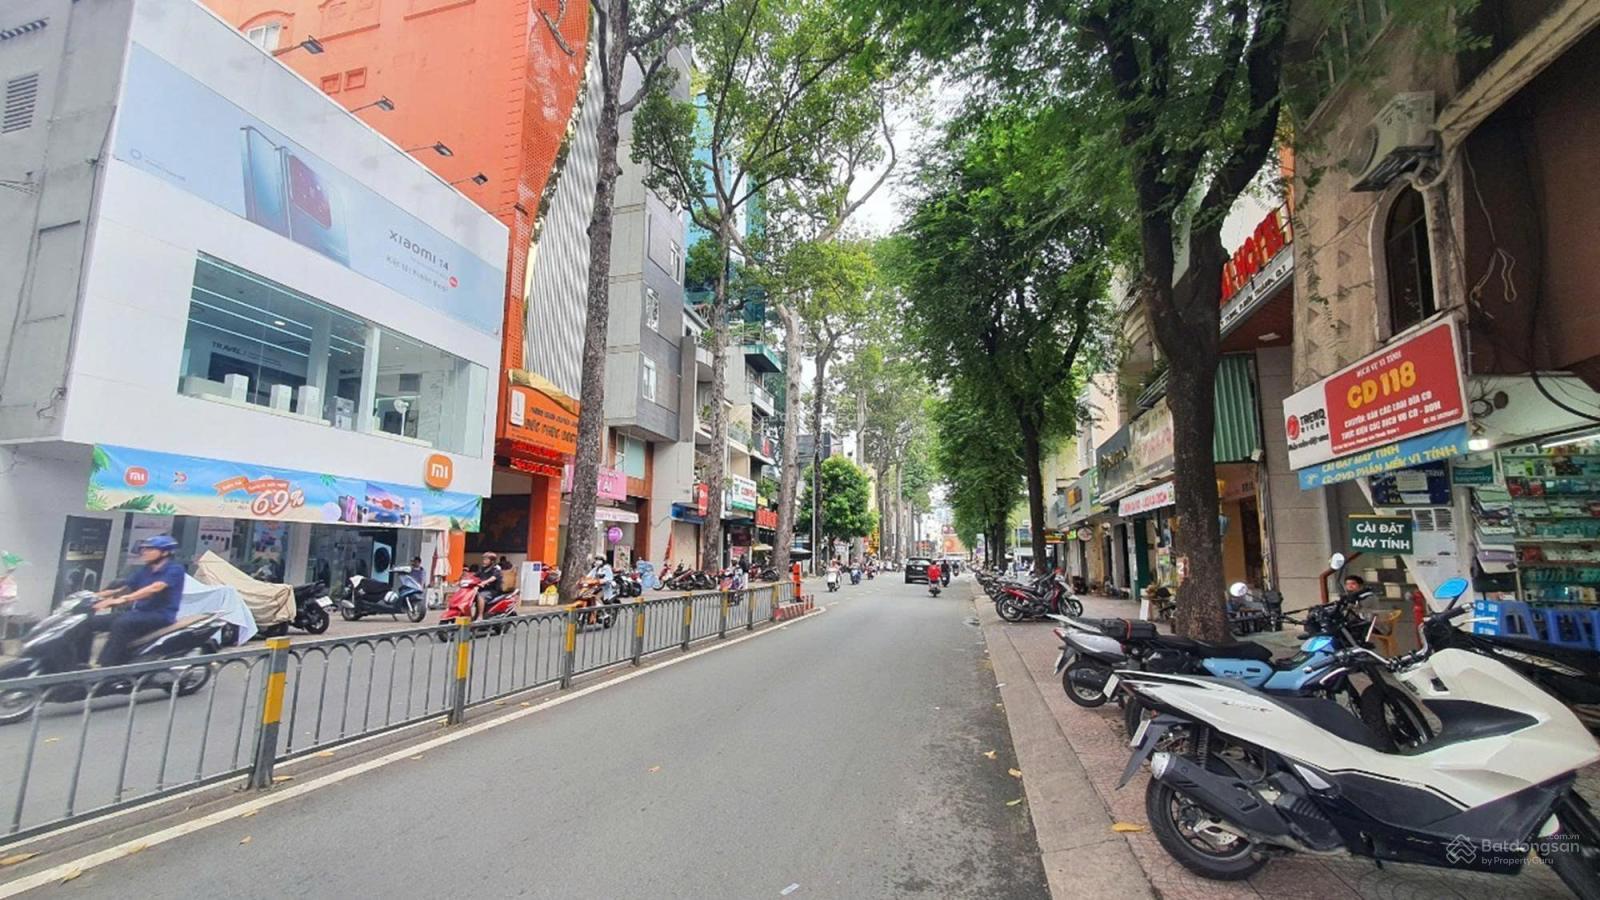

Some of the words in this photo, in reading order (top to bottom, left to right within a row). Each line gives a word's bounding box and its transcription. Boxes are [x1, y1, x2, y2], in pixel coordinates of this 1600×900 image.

[1347, 379, 1378, 409] CD
[1380, 360, 1416, 396] 118
[1423, 445, 1458, 461] TÍNH
[252, 489, 305, 516] 69%
[1356, 521, 1376, 533] CÀI
[1379, 522, 1405, 536] ĐẶT
[1352, 537, 1377, 548] MÁY
[1380, 536, 1410, 550] TÍNH
